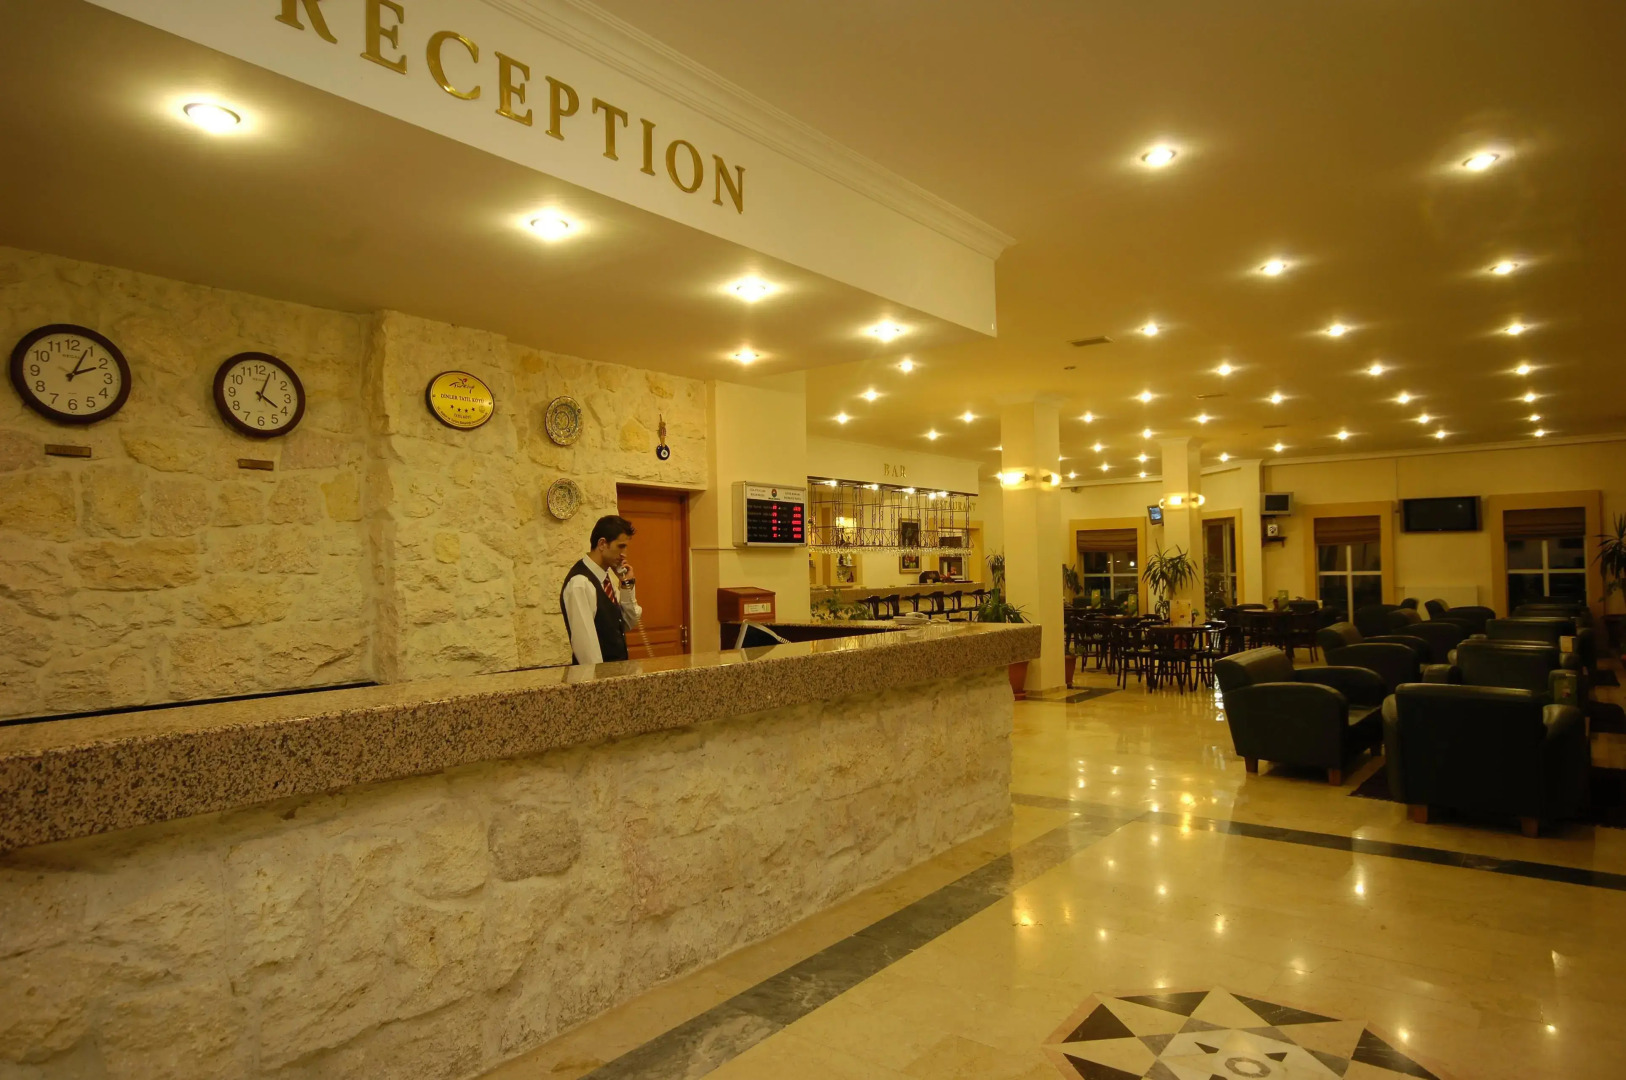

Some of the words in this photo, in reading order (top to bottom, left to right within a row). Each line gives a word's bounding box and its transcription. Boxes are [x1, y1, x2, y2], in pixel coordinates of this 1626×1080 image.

[48, 341, 61, 352] 11
[65, 339, 80, 351] 12
[34, 350, 50, 362] 10
[88, 346, 93, 357] 1
[99, 358, 108, 369] 2
[30, 365, 40, 376] 9
[241, 367, 251, 377] 11
[255, 364, 266, 375] 12
[272, 370, 276, 380] 1
[103, 373, 113, 384] 3
[231, 374, 243, 385] 10
[36, 381, 45, 392] 8
[280, 381, 287, 391] 2
[99, 388, 108, 398] 4
[228, 387, 236, 397] 9
[49, 393, 59, 404] 7
[86, 397, 95, 408] 5
[284, 394, 291, 403] 3
[68, 399, 77, 410] 6
[233, 401, 240, 410] 8
[243, 411, 250, 421] 7
[281, 406, 288, 416] 4
[257, 416, 264, 426] 6
[272, 414, 278, 424] 5
[884, 463, 907, 478] BAR
